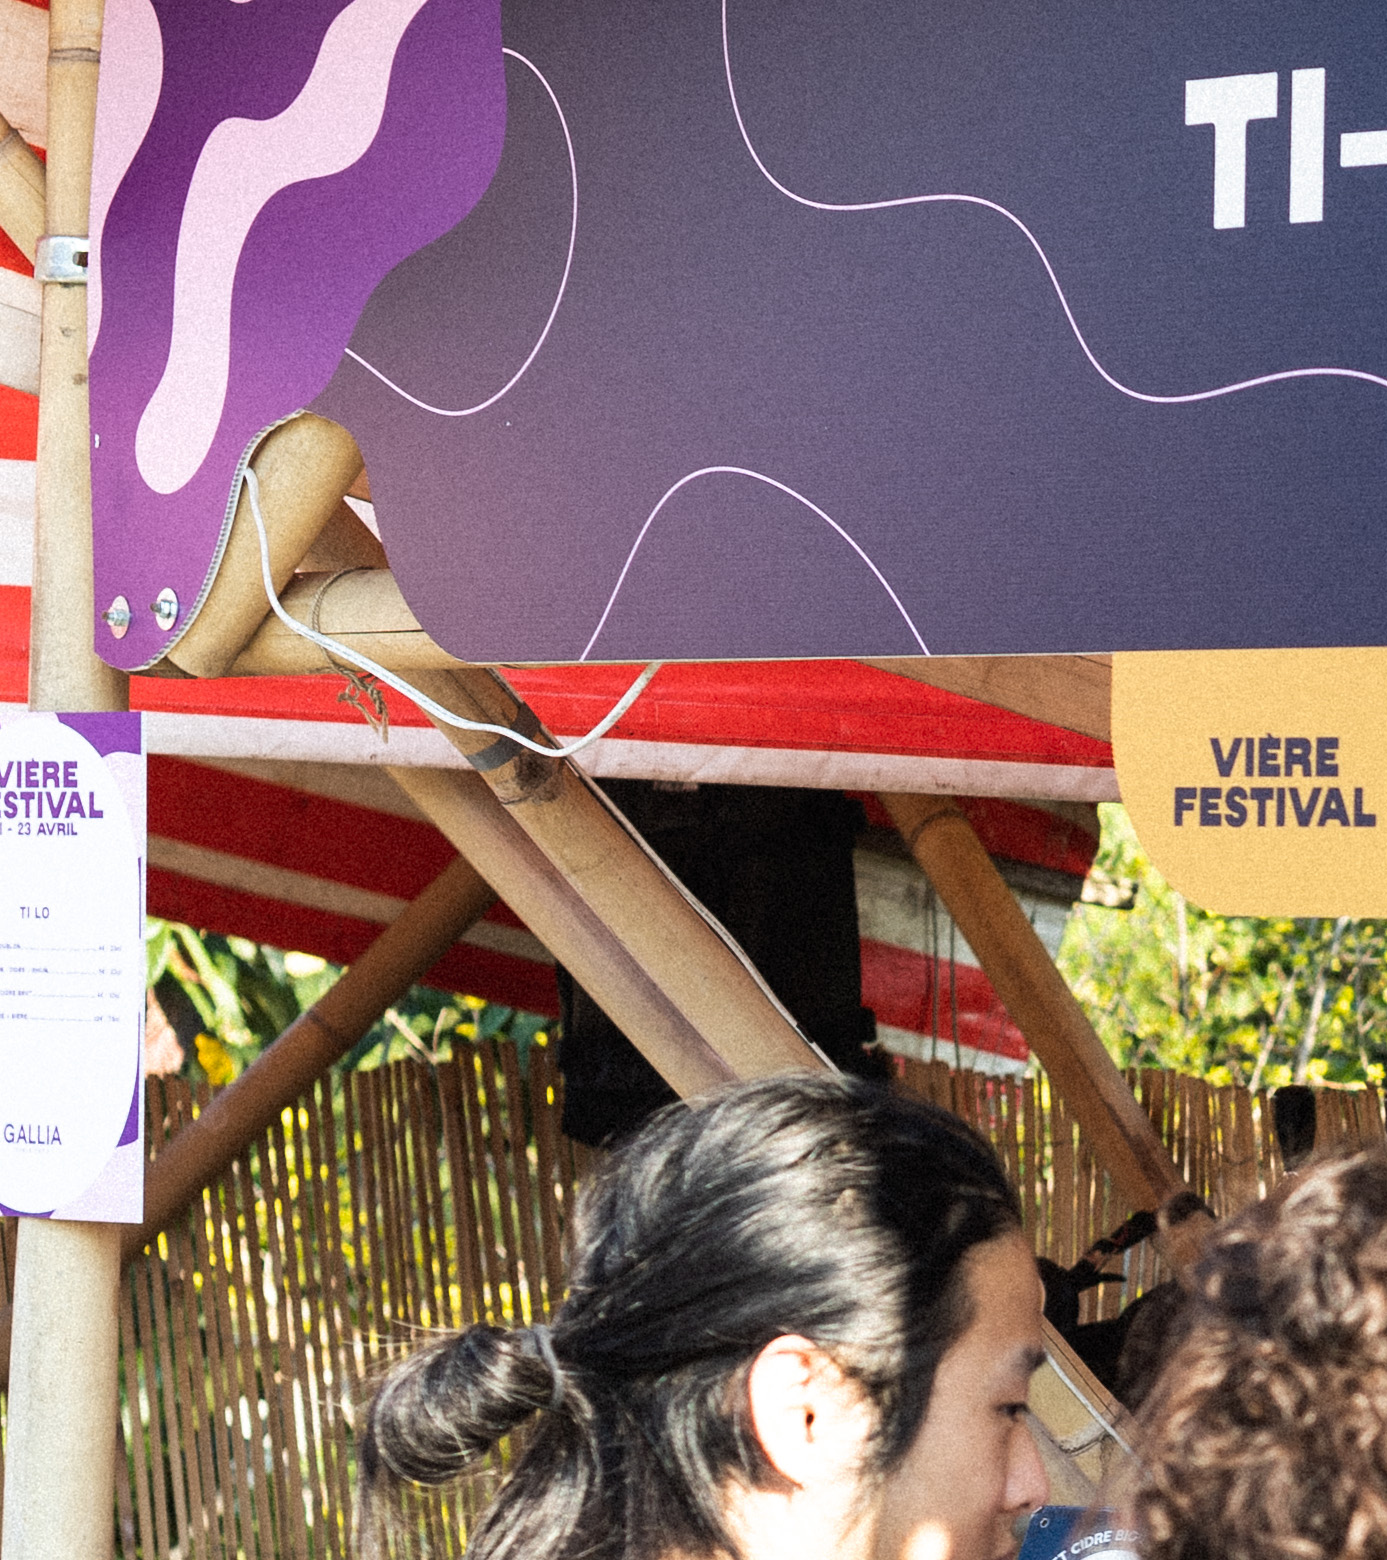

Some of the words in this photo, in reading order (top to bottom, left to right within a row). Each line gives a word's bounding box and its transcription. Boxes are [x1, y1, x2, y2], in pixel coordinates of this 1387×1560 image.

[1210, 733, 1339, 777] VIÈRE
[0, 758, 78, 788] VIÈRE
[0, 791, 103, 819] STIVAL
[1174, 787, 1376, 827] FESTIVAL
[17, 822, 31, 836] 23
[37, 822, 78, 836] AVRIL
[20, 906, 36, 920] TI
[37, 907, 50, 920] LO
[4, 1123, 62, 1145] GALLIA
[1070, 1530, 1113, 1555] CIDRE
